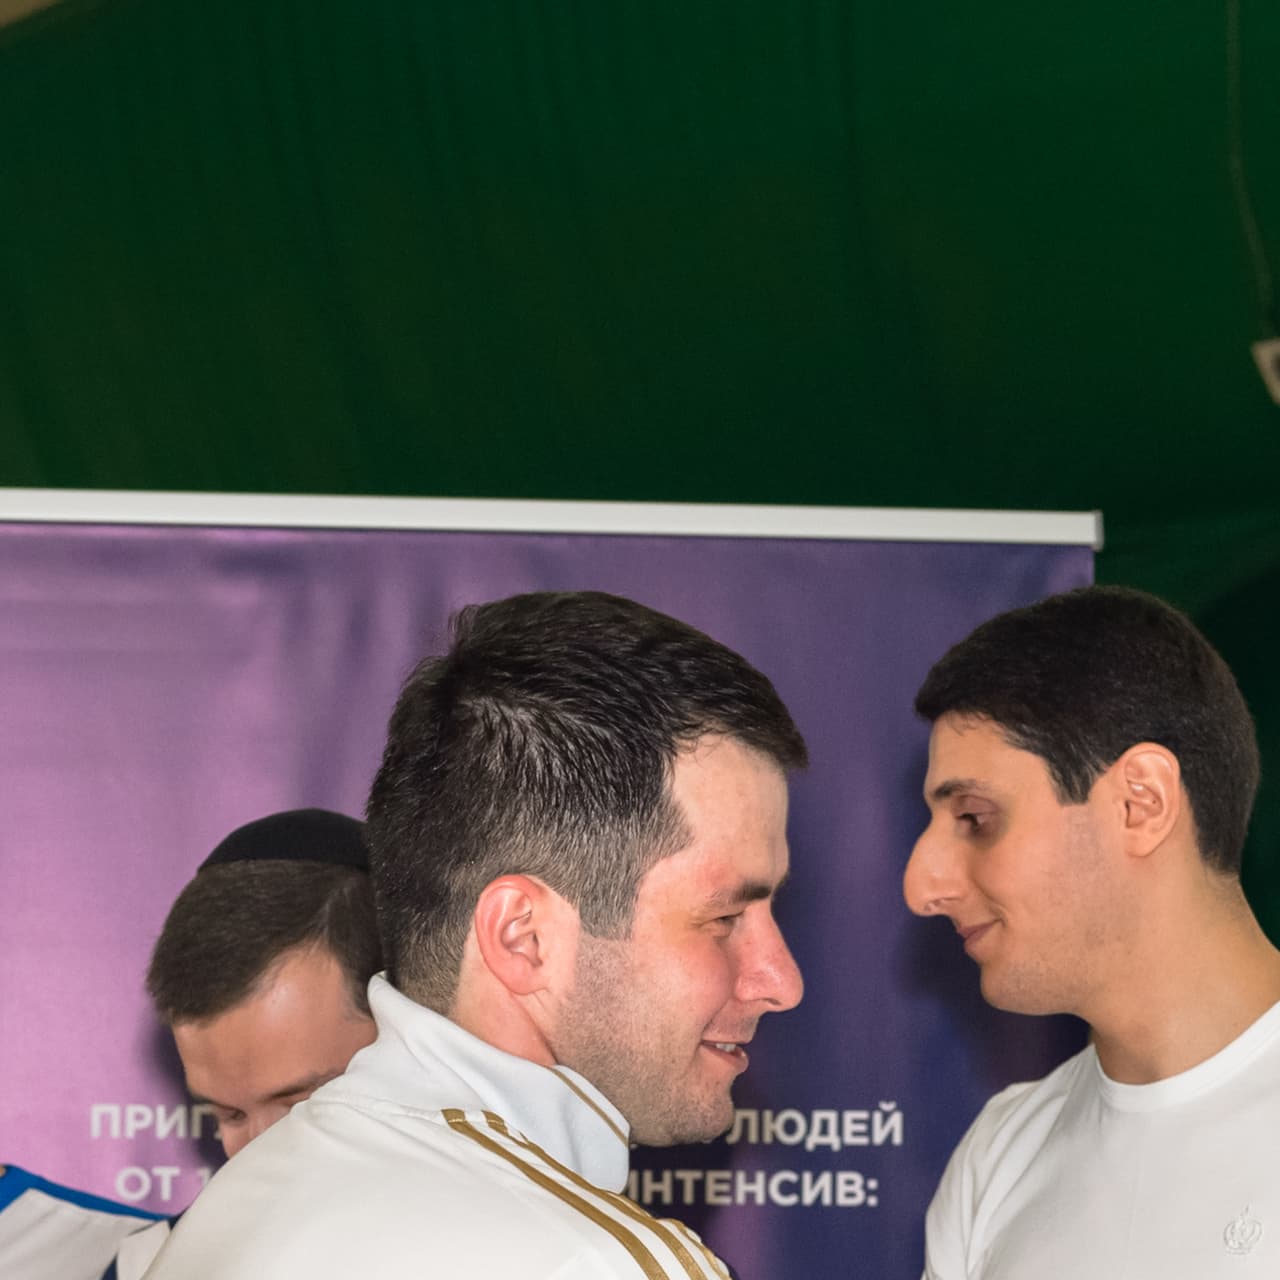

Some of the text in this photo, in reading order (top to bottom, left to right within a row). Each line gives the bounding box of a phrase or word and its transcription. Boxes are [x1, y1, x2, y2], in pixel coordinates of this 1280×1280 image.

[90, 1101, 904, 1151] ПРИГ ЛЮДЕЙ
[115, 1166, 181, 1202] ОТ
